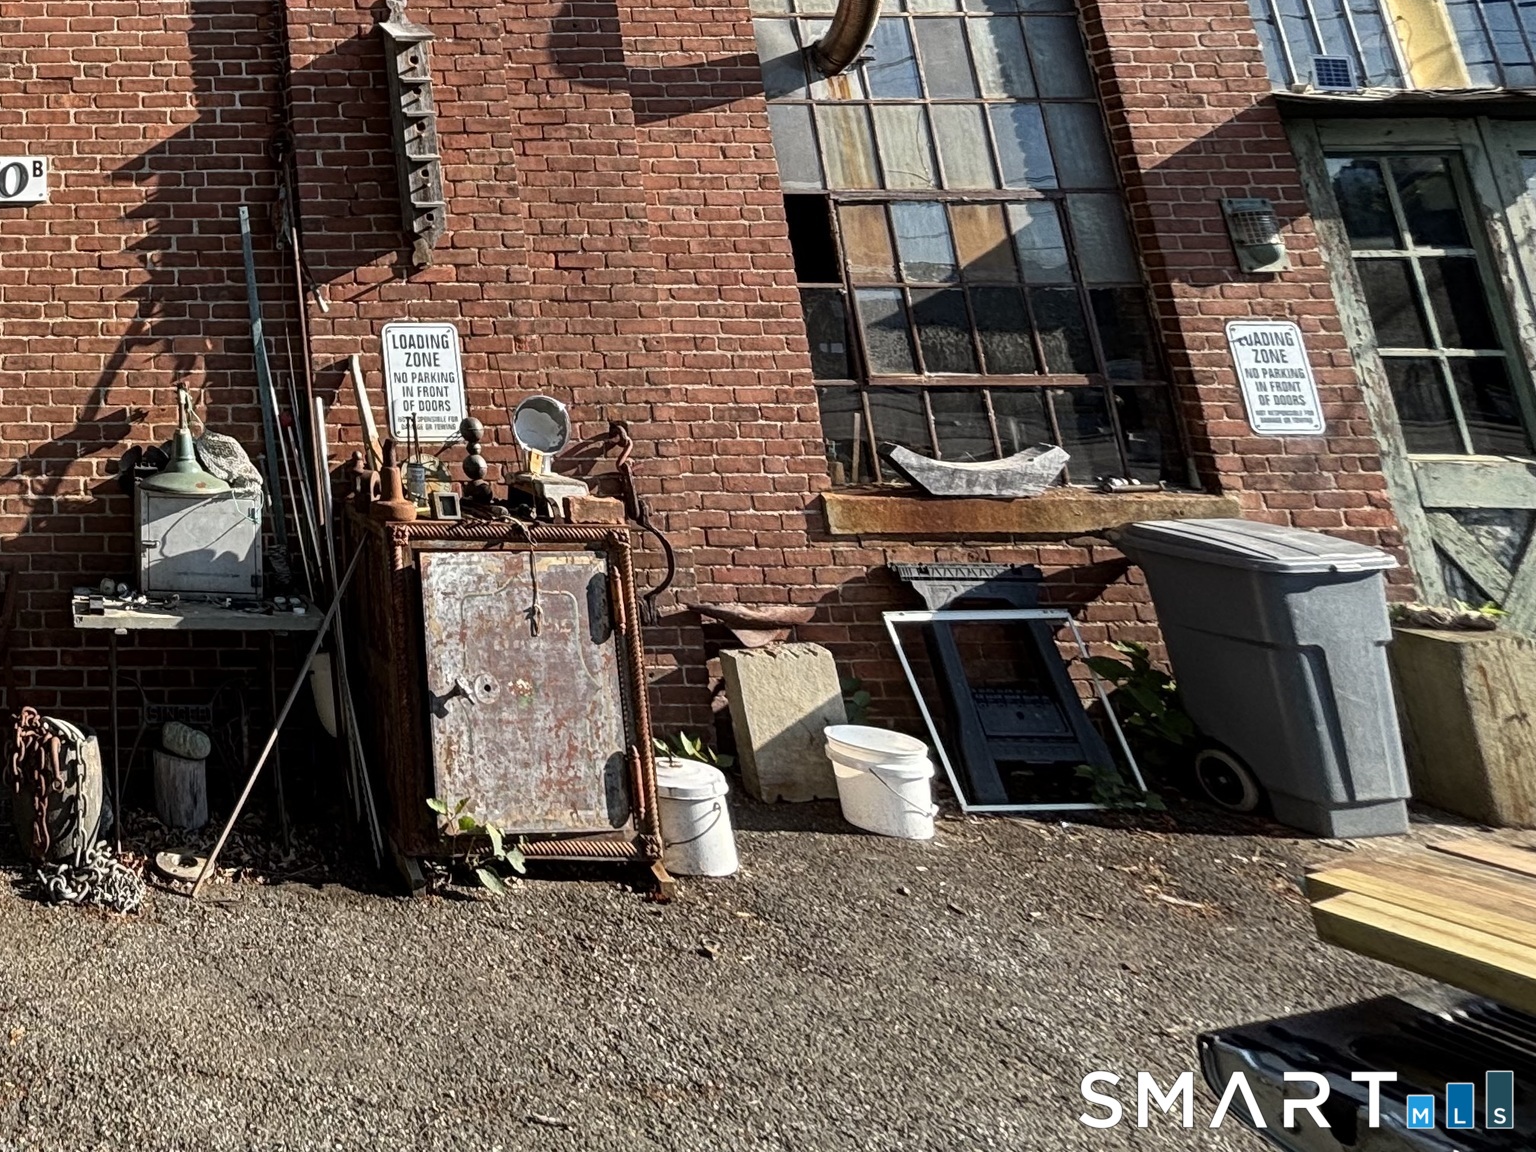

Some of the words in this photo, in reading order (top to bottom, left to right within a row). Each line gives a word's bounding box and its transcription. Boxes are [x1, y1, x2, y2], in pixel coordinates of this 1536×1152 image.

[392, 334, 449, 349] LOADING
[404, 352, 440, 367] ZONE
[1252, 349, 1288, 363] ZONE
[394, 372, 408, 383] NO
[411, 372, 455, 383] PARKING
[1245, 368, 1259, 379] NO
[1263, 368, 1305, 379] PARKING
[402, 386, 414, 397] IN
[417, 386, 449, 397] FRONT
[1255, 381, 1266, 392] IN
[1270, 381, 1301, 392] FRONT
[403, 400, 415, 411] OF
[418, 400, 451, 411] DOORS
[1258, 395, 1270, 406] OF
[1273, 395, 1306, 406] DOORS
[148, 706, 207, 721] SINGER
